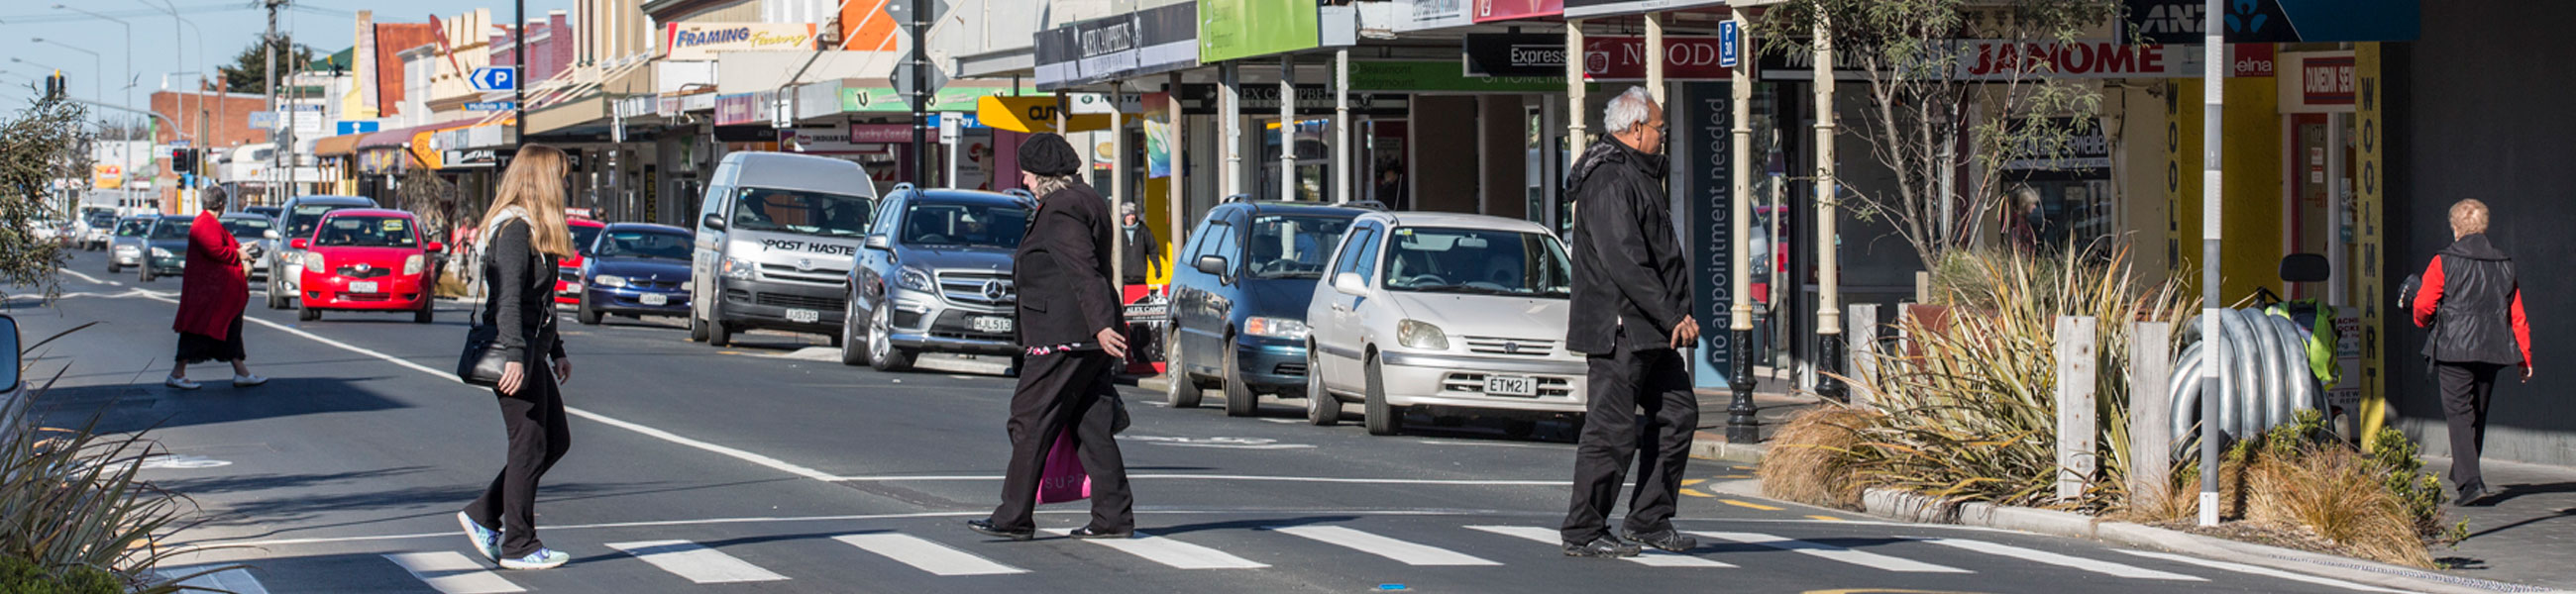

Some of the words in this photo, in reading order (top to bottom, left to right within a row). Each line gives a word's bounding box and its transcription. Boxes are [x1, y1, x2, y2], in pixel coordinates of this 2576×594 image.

[676, 27, 751, 48] FRAMING
[749, 31, 807, 48] Factory
[1725, 24, 1732, 40] P
[1511, 48, 1566, 65] Express
[1725, 42, 1732, 55] 30
[1968, 43, 2165, 74] JANOME
[2236, 56, 2272, 72] elna
[495, 72, 507, 86] P
[1706, 98, 1726, 179] needed
[2361, 77, 2377, 400] WOOLMART
[760, 239, 805, 251] POST
[807, 243, 855, 256] HASTE
[1708, 184, 1731, 329] appointment
[1713, 332, 1726, 363] no
[1489, 378, 1529, 393] ETM21
